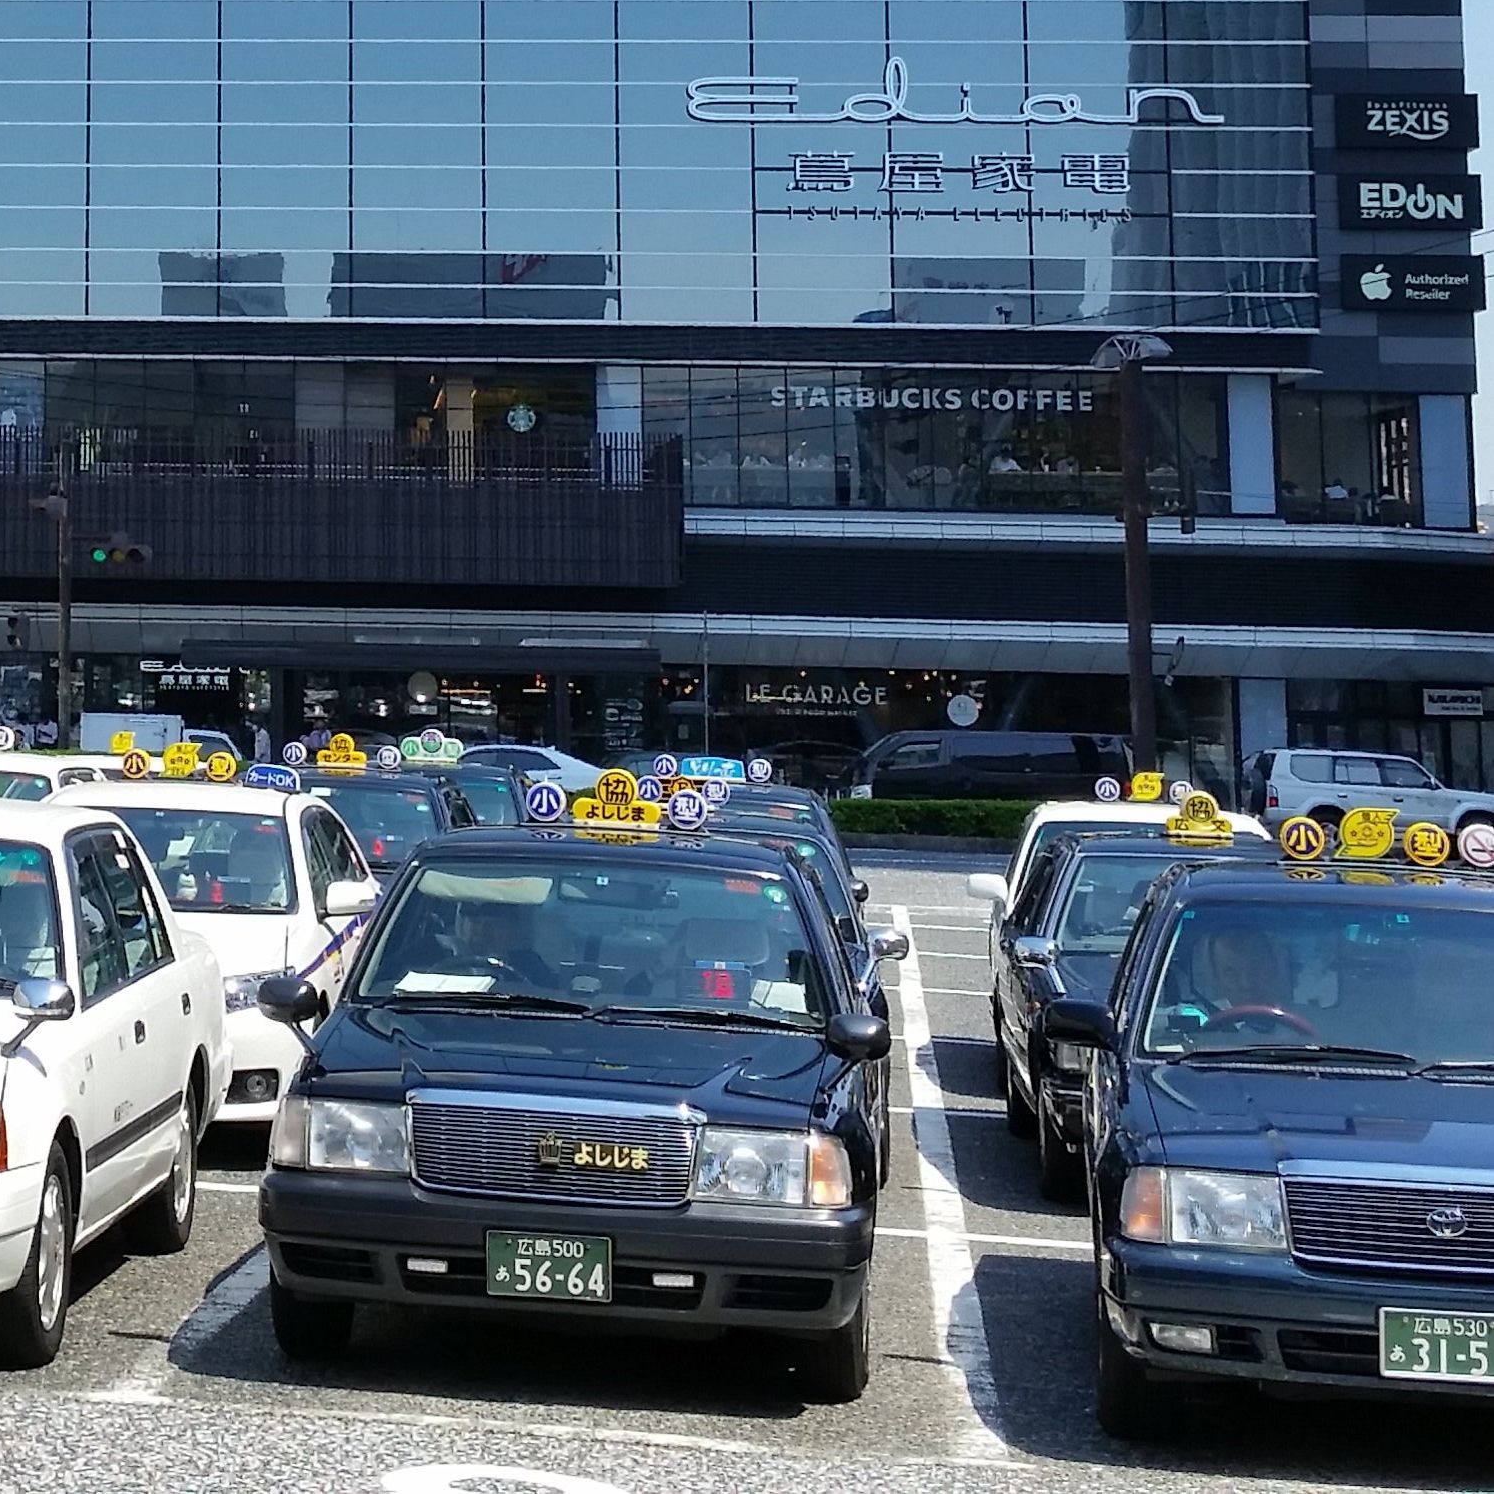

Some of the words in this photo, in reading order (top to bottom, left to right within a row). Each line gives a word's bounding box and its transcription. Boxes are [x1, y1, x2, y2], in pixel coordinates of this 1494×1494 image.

[1366, 110, 1449, 139] ZEXIS
[1360, 209, 1404, 219] エディオン
[1405, 273, 1469, 286] Authorized
[1405, 289, 1451, 300] Reseller
[770, 385, 963, 410] STARBUCKS
[971, 387, 1094, 412] COFFEE
[745, 683, 772, 703] LE
[782, 684, 889, 706] GARAGE
[125, 754, 144, 773] 小
[656, 758, 673, 774] 小
[249, 771, 295, 788] カードOK
[639, 779, 659, 799] 小
[1100, 781, 1116, 797] 小
[602, 778, 629, 803] 協
[532, 790, 557, 814] 小
[674, 796, 700, 822] 型
[585, 804, 645, 822] よしじま
[1288, 824, 1318, 851] 小
[1413, 831, 1442, 856] 型
[573, 1145, 650, 1170] よしじま
[517, 1239, 585, 1258] 広島500
[495, 1264, 511, 1282] あ
[514, 1258, 605, 1297] 56-64
[1413, 1317, 1488, 1337] 広島530
[1389, 1344, 1406, 1363] あ
